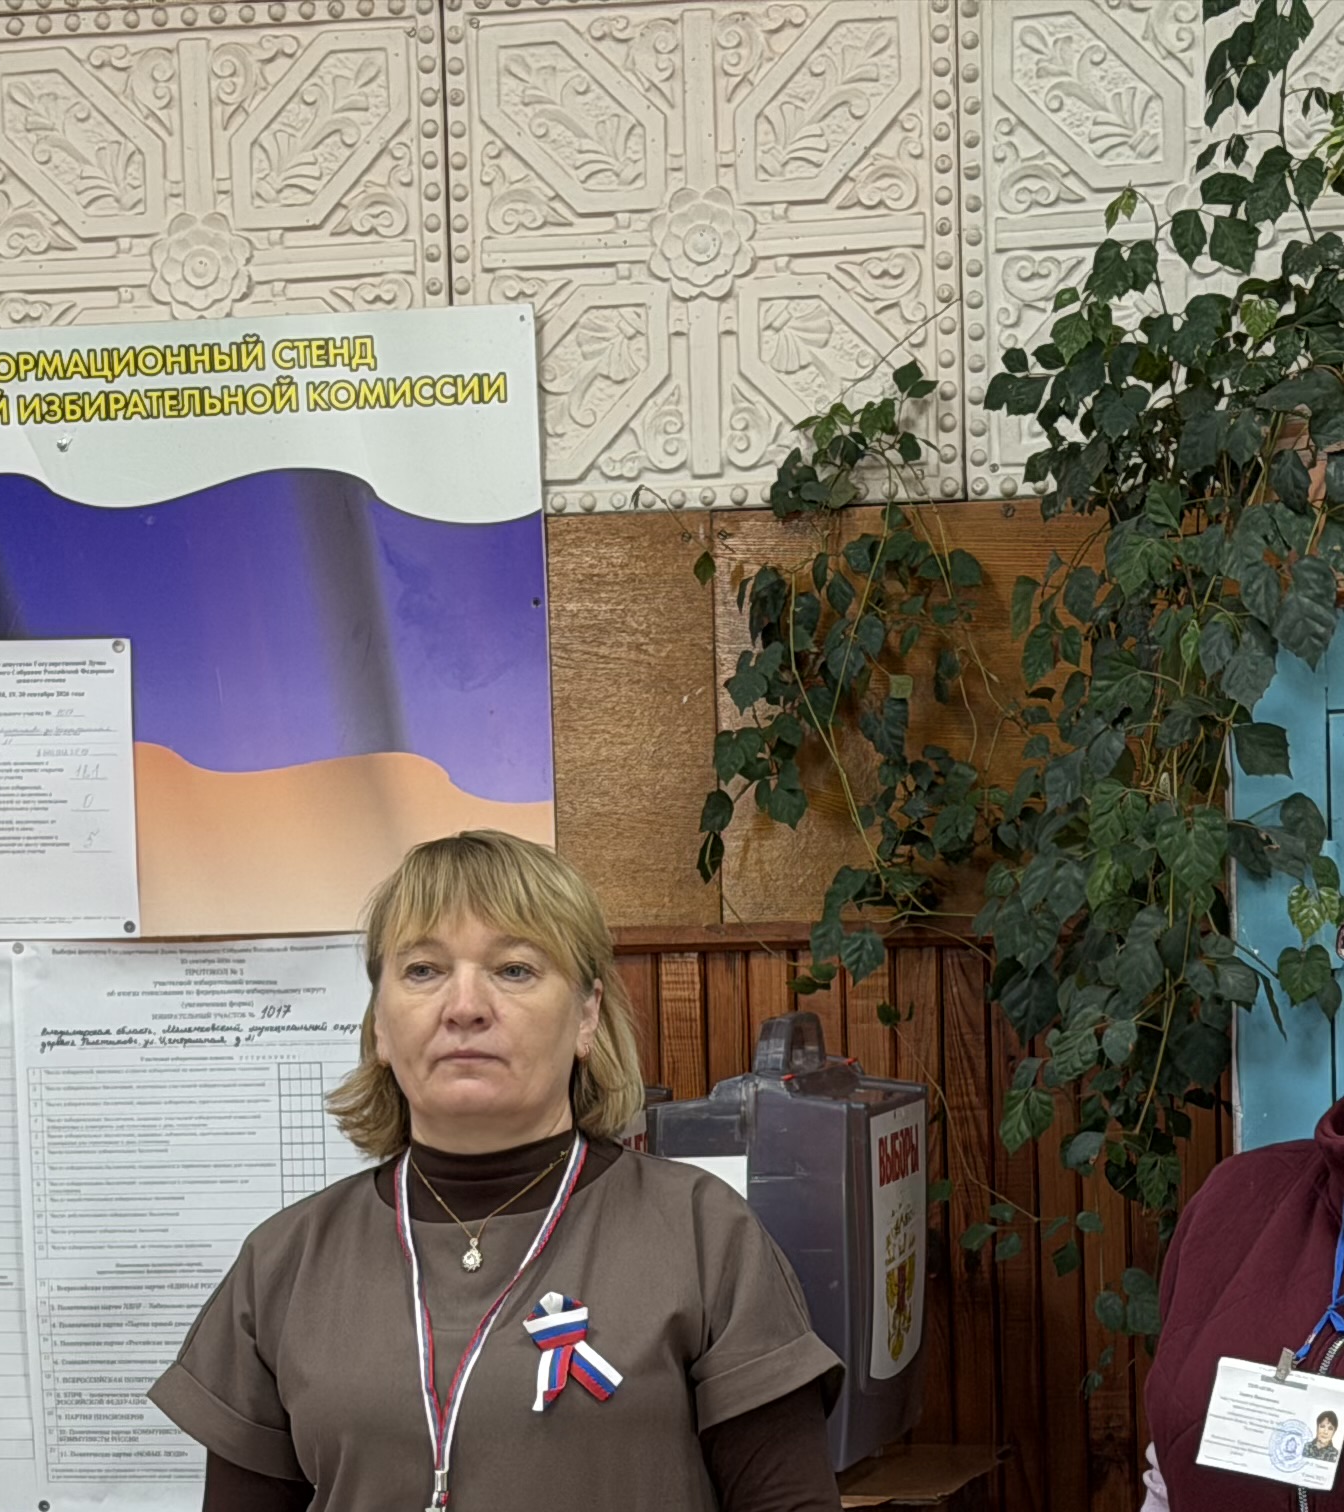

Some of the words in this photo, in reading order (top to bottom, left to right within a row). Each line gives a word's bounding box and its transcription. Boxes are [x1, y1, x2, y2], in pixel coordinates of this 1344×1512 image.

[271, 335, 377, 373] СТЕНД
[15, 375, 300, 426] ИЗБИРАТЕЛЬНОЙ
[306, 371, 508, 413] КОМИССИИ
[260, 1003, 292, 1020] 1017
[878, 1122, 920, 1189] ВЫБОРЫ
